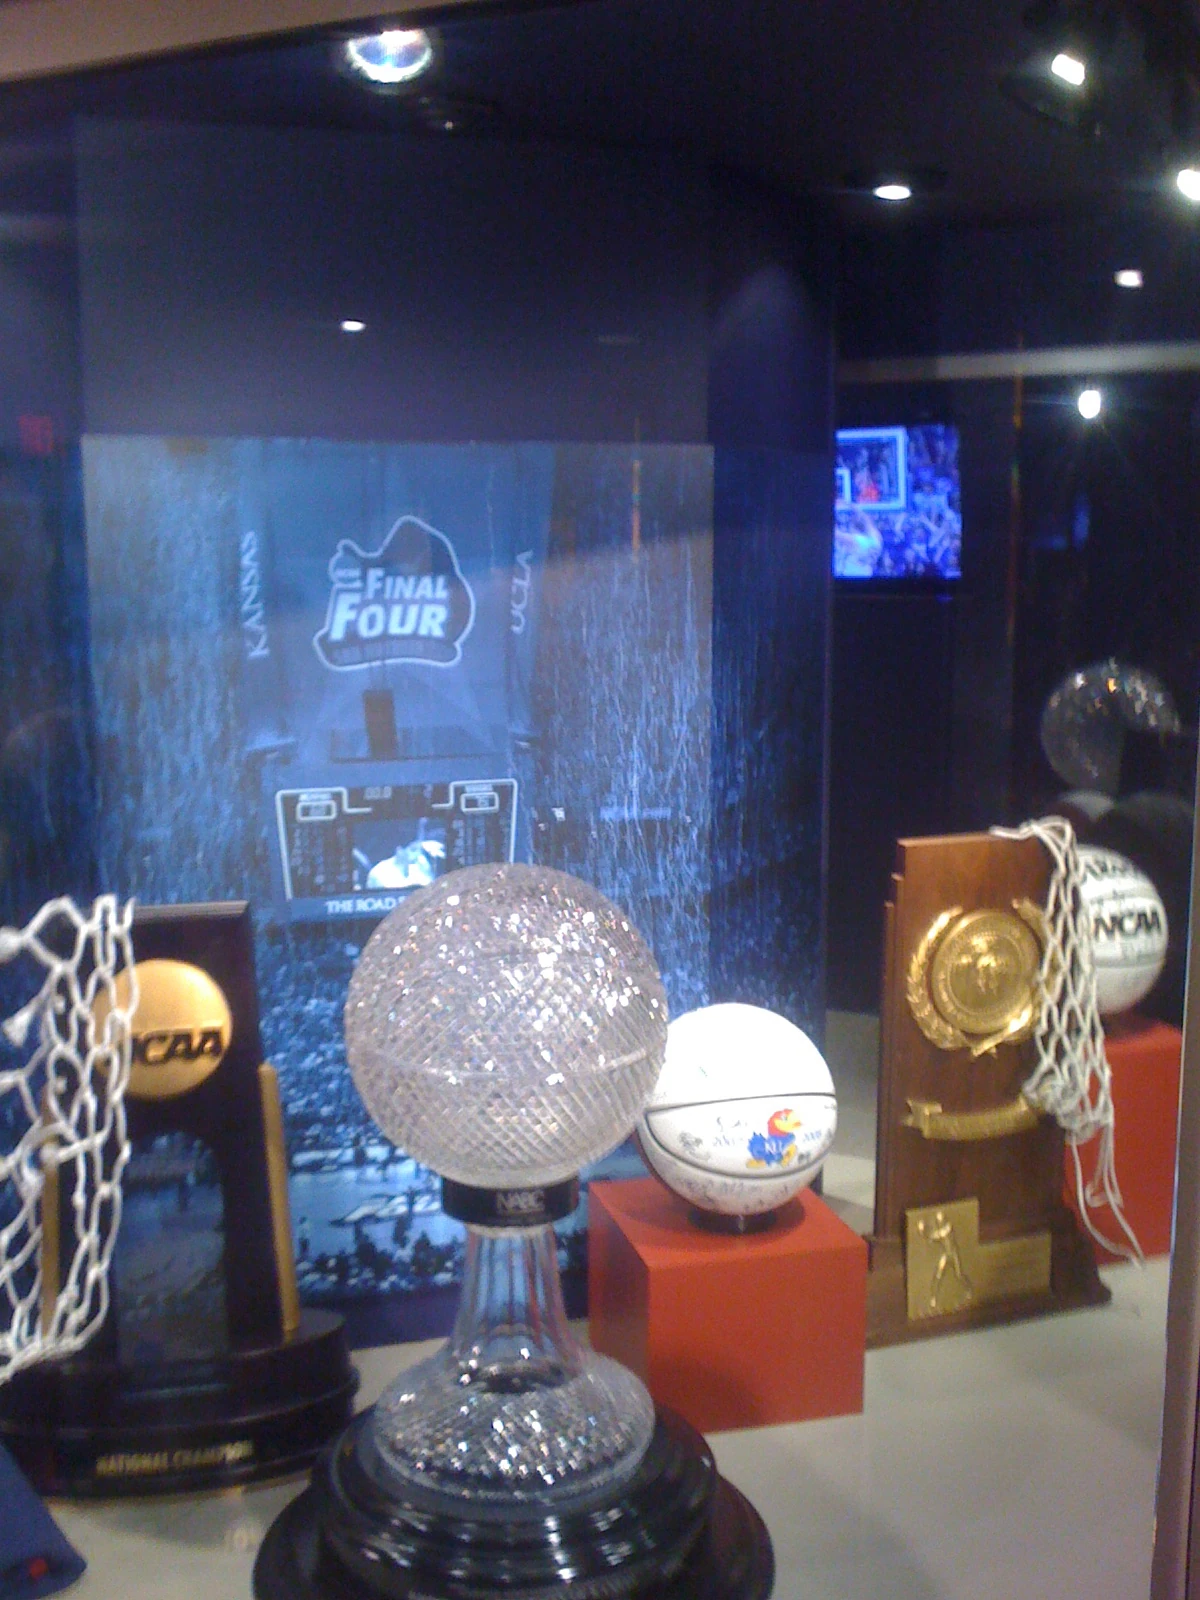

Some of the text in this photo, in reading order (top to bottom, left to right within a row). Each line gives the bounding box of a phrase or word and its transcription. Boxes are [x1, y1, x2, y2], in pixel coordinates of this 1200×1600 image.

[239, 531, 269, 659] KANSAS
[365, 566, 449, 600] FINAL
[511, 550, 534, 635] UCLA
[328, 592, 448, 642] FOUR
[326, 900, 353, 915] THE
[355, 897, 397, 912] ROAD
[1094, 910, 1162, 941] NCAA
